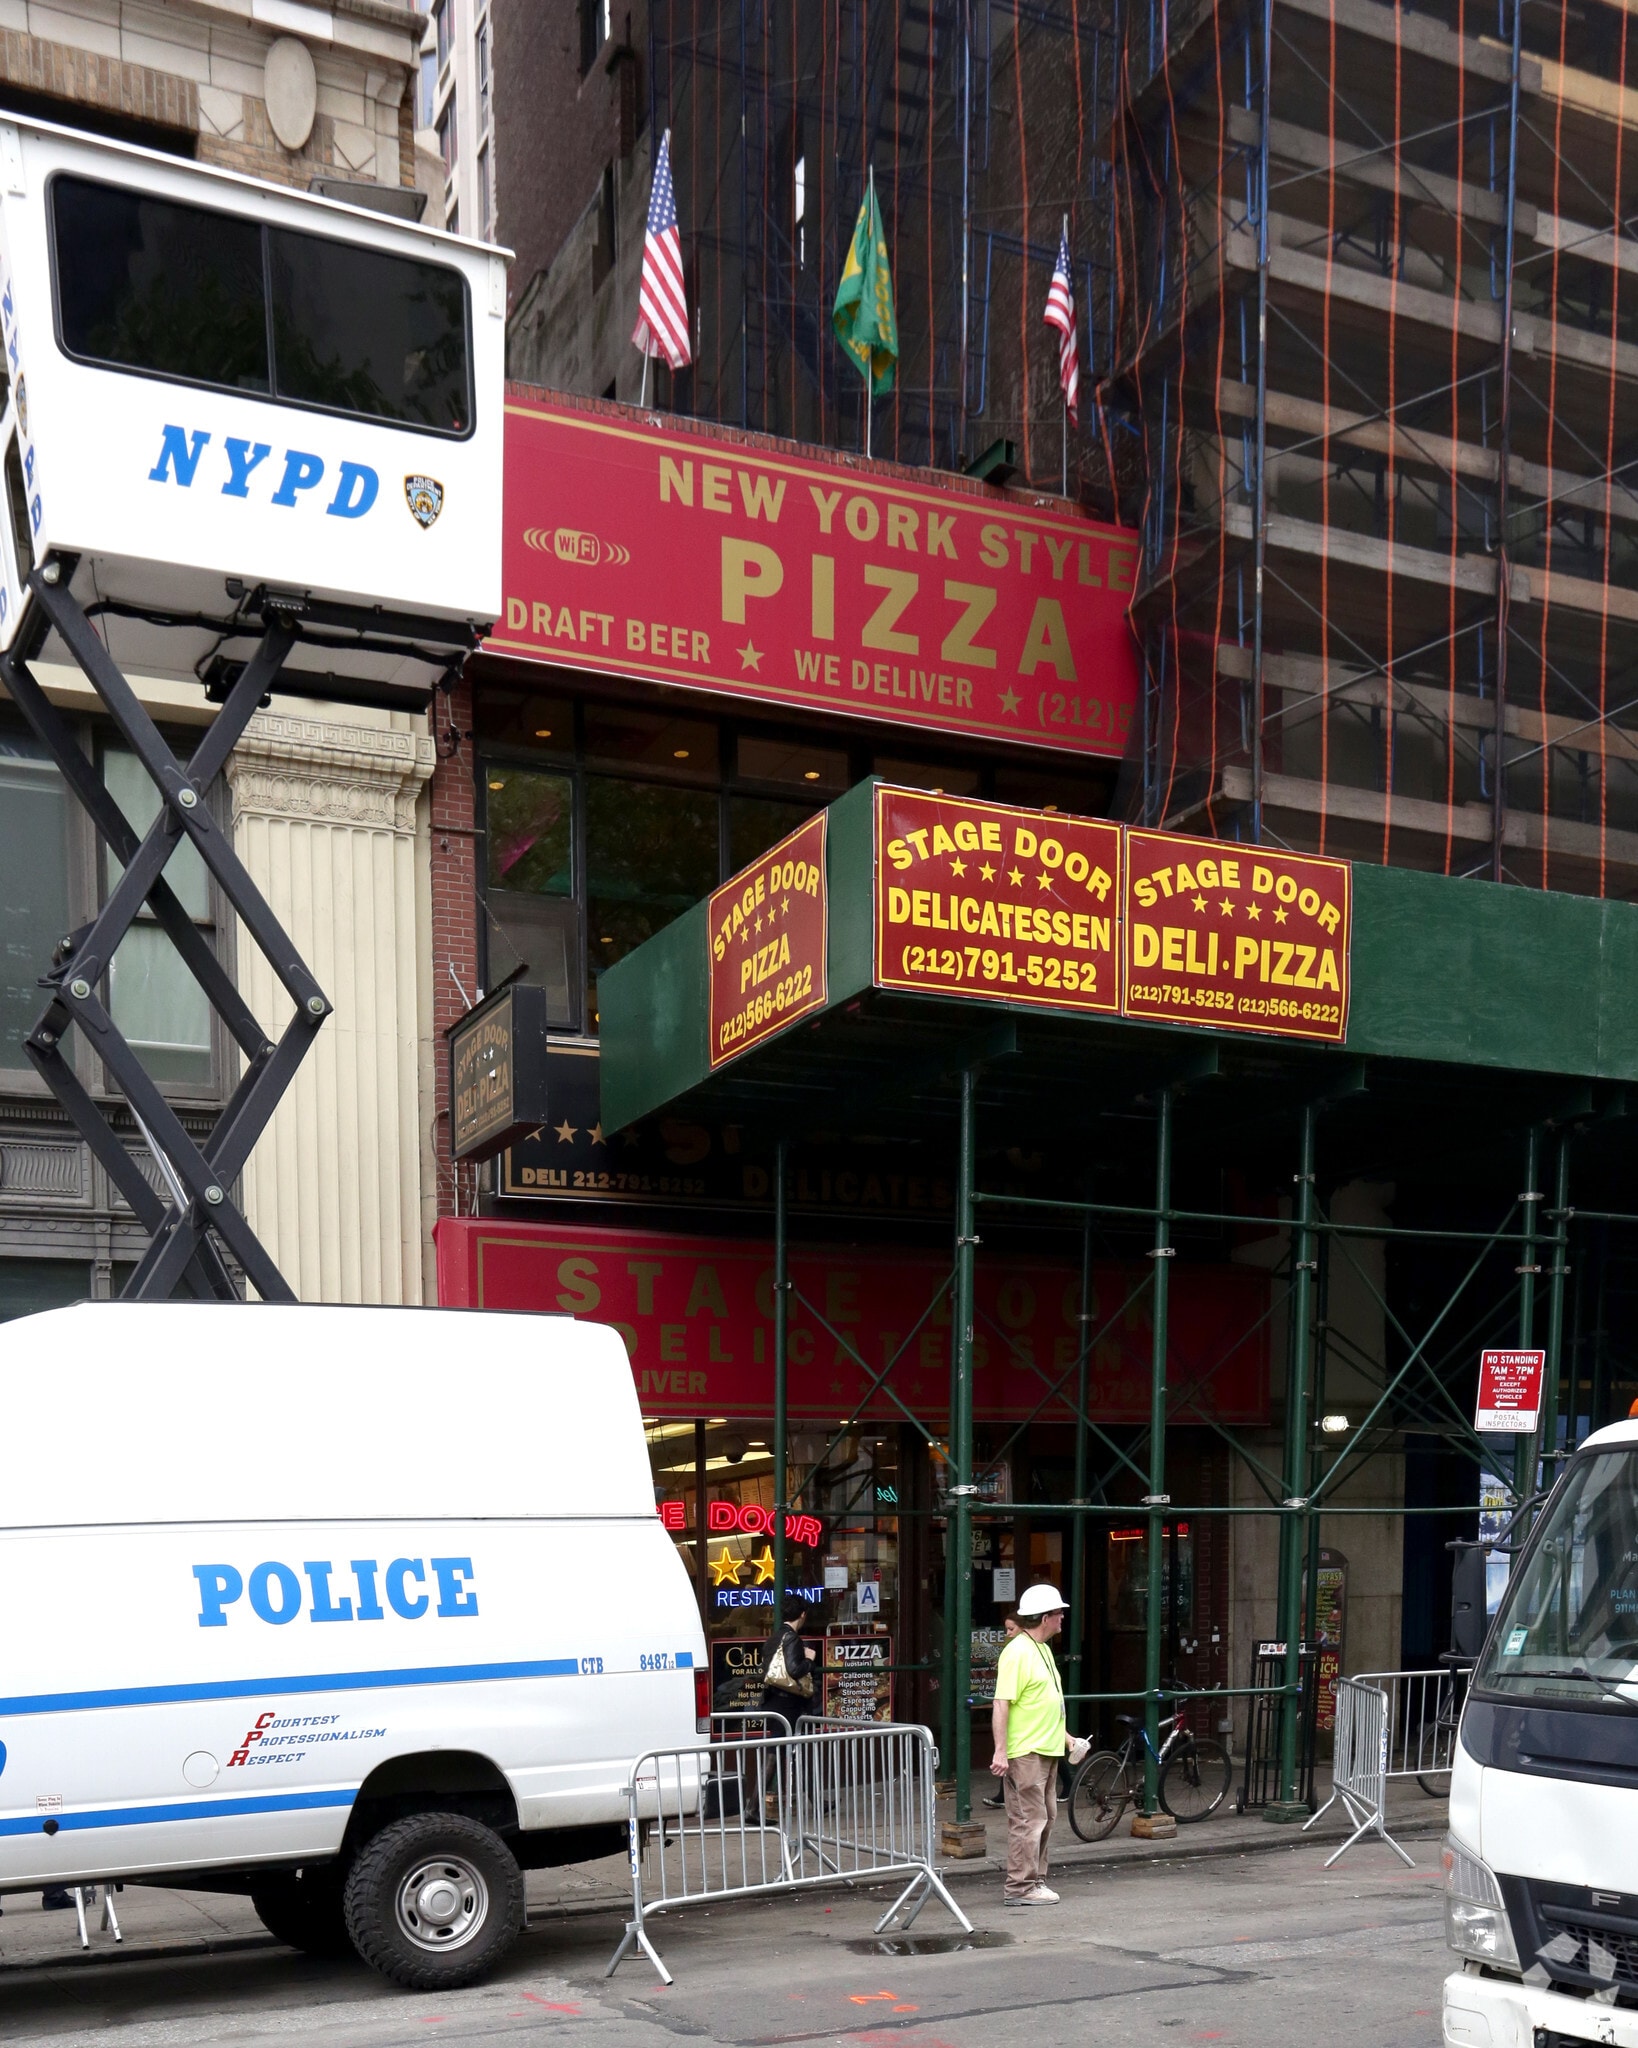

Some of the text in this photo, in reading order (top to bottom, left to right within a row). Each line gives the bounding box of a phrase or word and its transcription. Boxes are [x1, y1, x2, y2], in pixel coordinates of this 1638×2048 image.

[148, 424, 379, 519] NYPD
[658, 454, 1135, 593] NEW YORK STYLE
[506, 596, 711, 665] DRAFT BEER
[720, 536, 1079, 683] PIZZA
[794, 648, 974, 709] WE DELIVER
[886, 820, 1113, 903] STAGE DOOR
[713, 860, 820, 962] STAGE DOOR
[888, 886, 1111, 953] DELICATESSEN
[1133, 859, 1342, 936] STAGE DOOR
[740, 931, 791, 995] PIZZA
[901, 945, 1098, 993] (212)791-5252
[719, 963, 813, 1051] (212)566-6222
[1129, 984, 1340, 1024] (212)791-5252 (212)566-6222
[456, 1023, 510, 1086] STAGE DOOR
[521, 1167, 568, 1187] DELI
[555, 1256, 863, 1323] STAGE
[1487, 1355, 1539, 1364] NO STANDING
[1490, 1366, 1508, 1375] 7AM
[1516, 1366, 1535, 1375] 7PM
[1485, 1420, 1527, 1428] INSPECTORS
[192, 1557, 480, 1628] POLICE
[861, 1585, 876, 1604] A
[1610, 1589, 1636, 1599] PLAN
[725, 1646, 764, 1668] Cat
[834, 1644, 882, 1660] PIZZA
[971, 1630, 1005, 1643] FREE
[581, 1657, 604, 1674] CTB
[640, 1653, 668, 1671] 8487
[729, 1700, 751, 1708] Heroes
[738, 1691, 749, 1699] Hot
[745, 1682, 756, 1690] Hot
[843, 1697, 874, 1705] Espresso
[629, 1820, 638, 1875] NYPD
